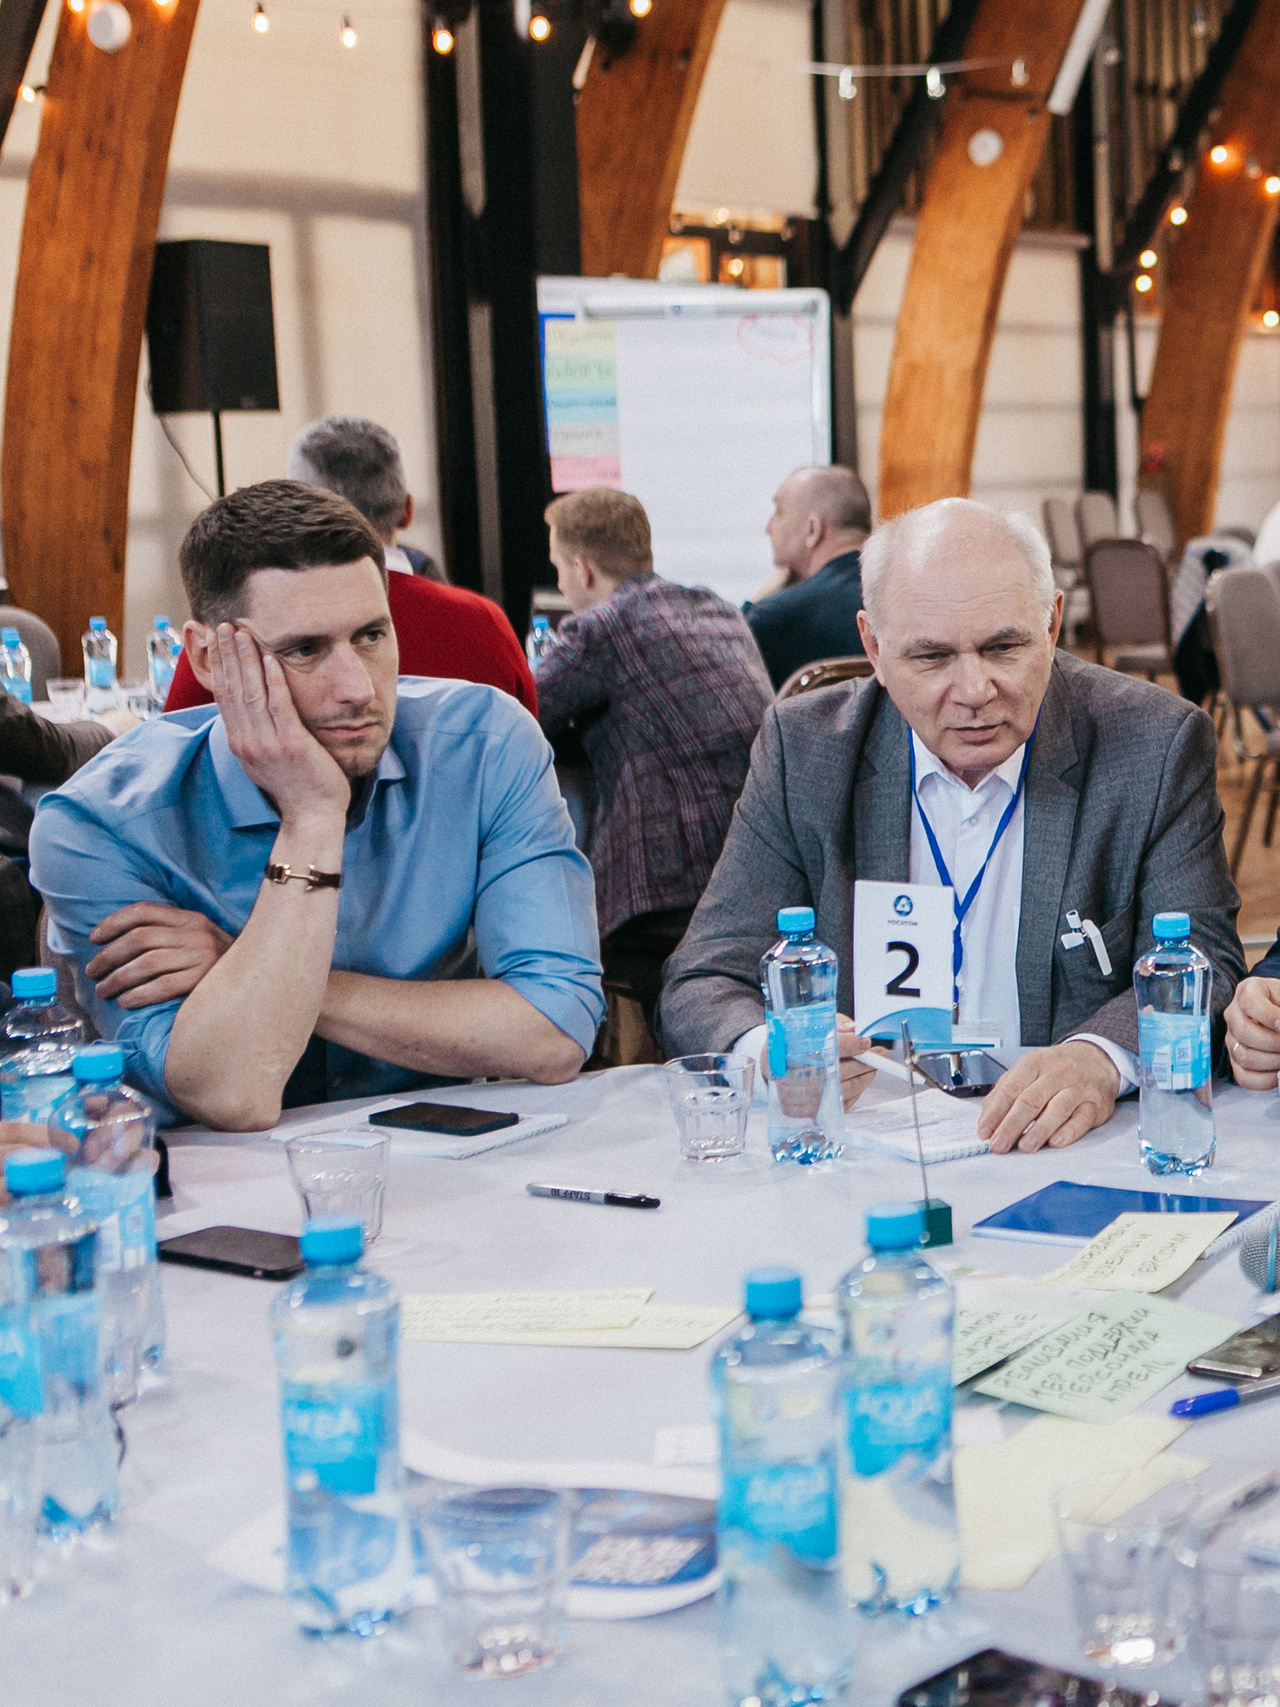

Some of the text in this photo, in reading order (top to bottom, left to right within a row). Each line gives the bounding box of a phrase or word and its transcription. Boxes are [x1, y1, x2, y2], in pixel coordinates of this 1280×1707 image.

[887, 919, 918, 927] РОСАТОМ
[885, 940, 921, 998] 2
[993, 1312, 1109, 1388] РЕАЛИЗАЦИЯ
[1058, 1331, 1162, 1398] ПЕРСОНАЛА
[1026, 1373, 1064, 1398] МЕР
